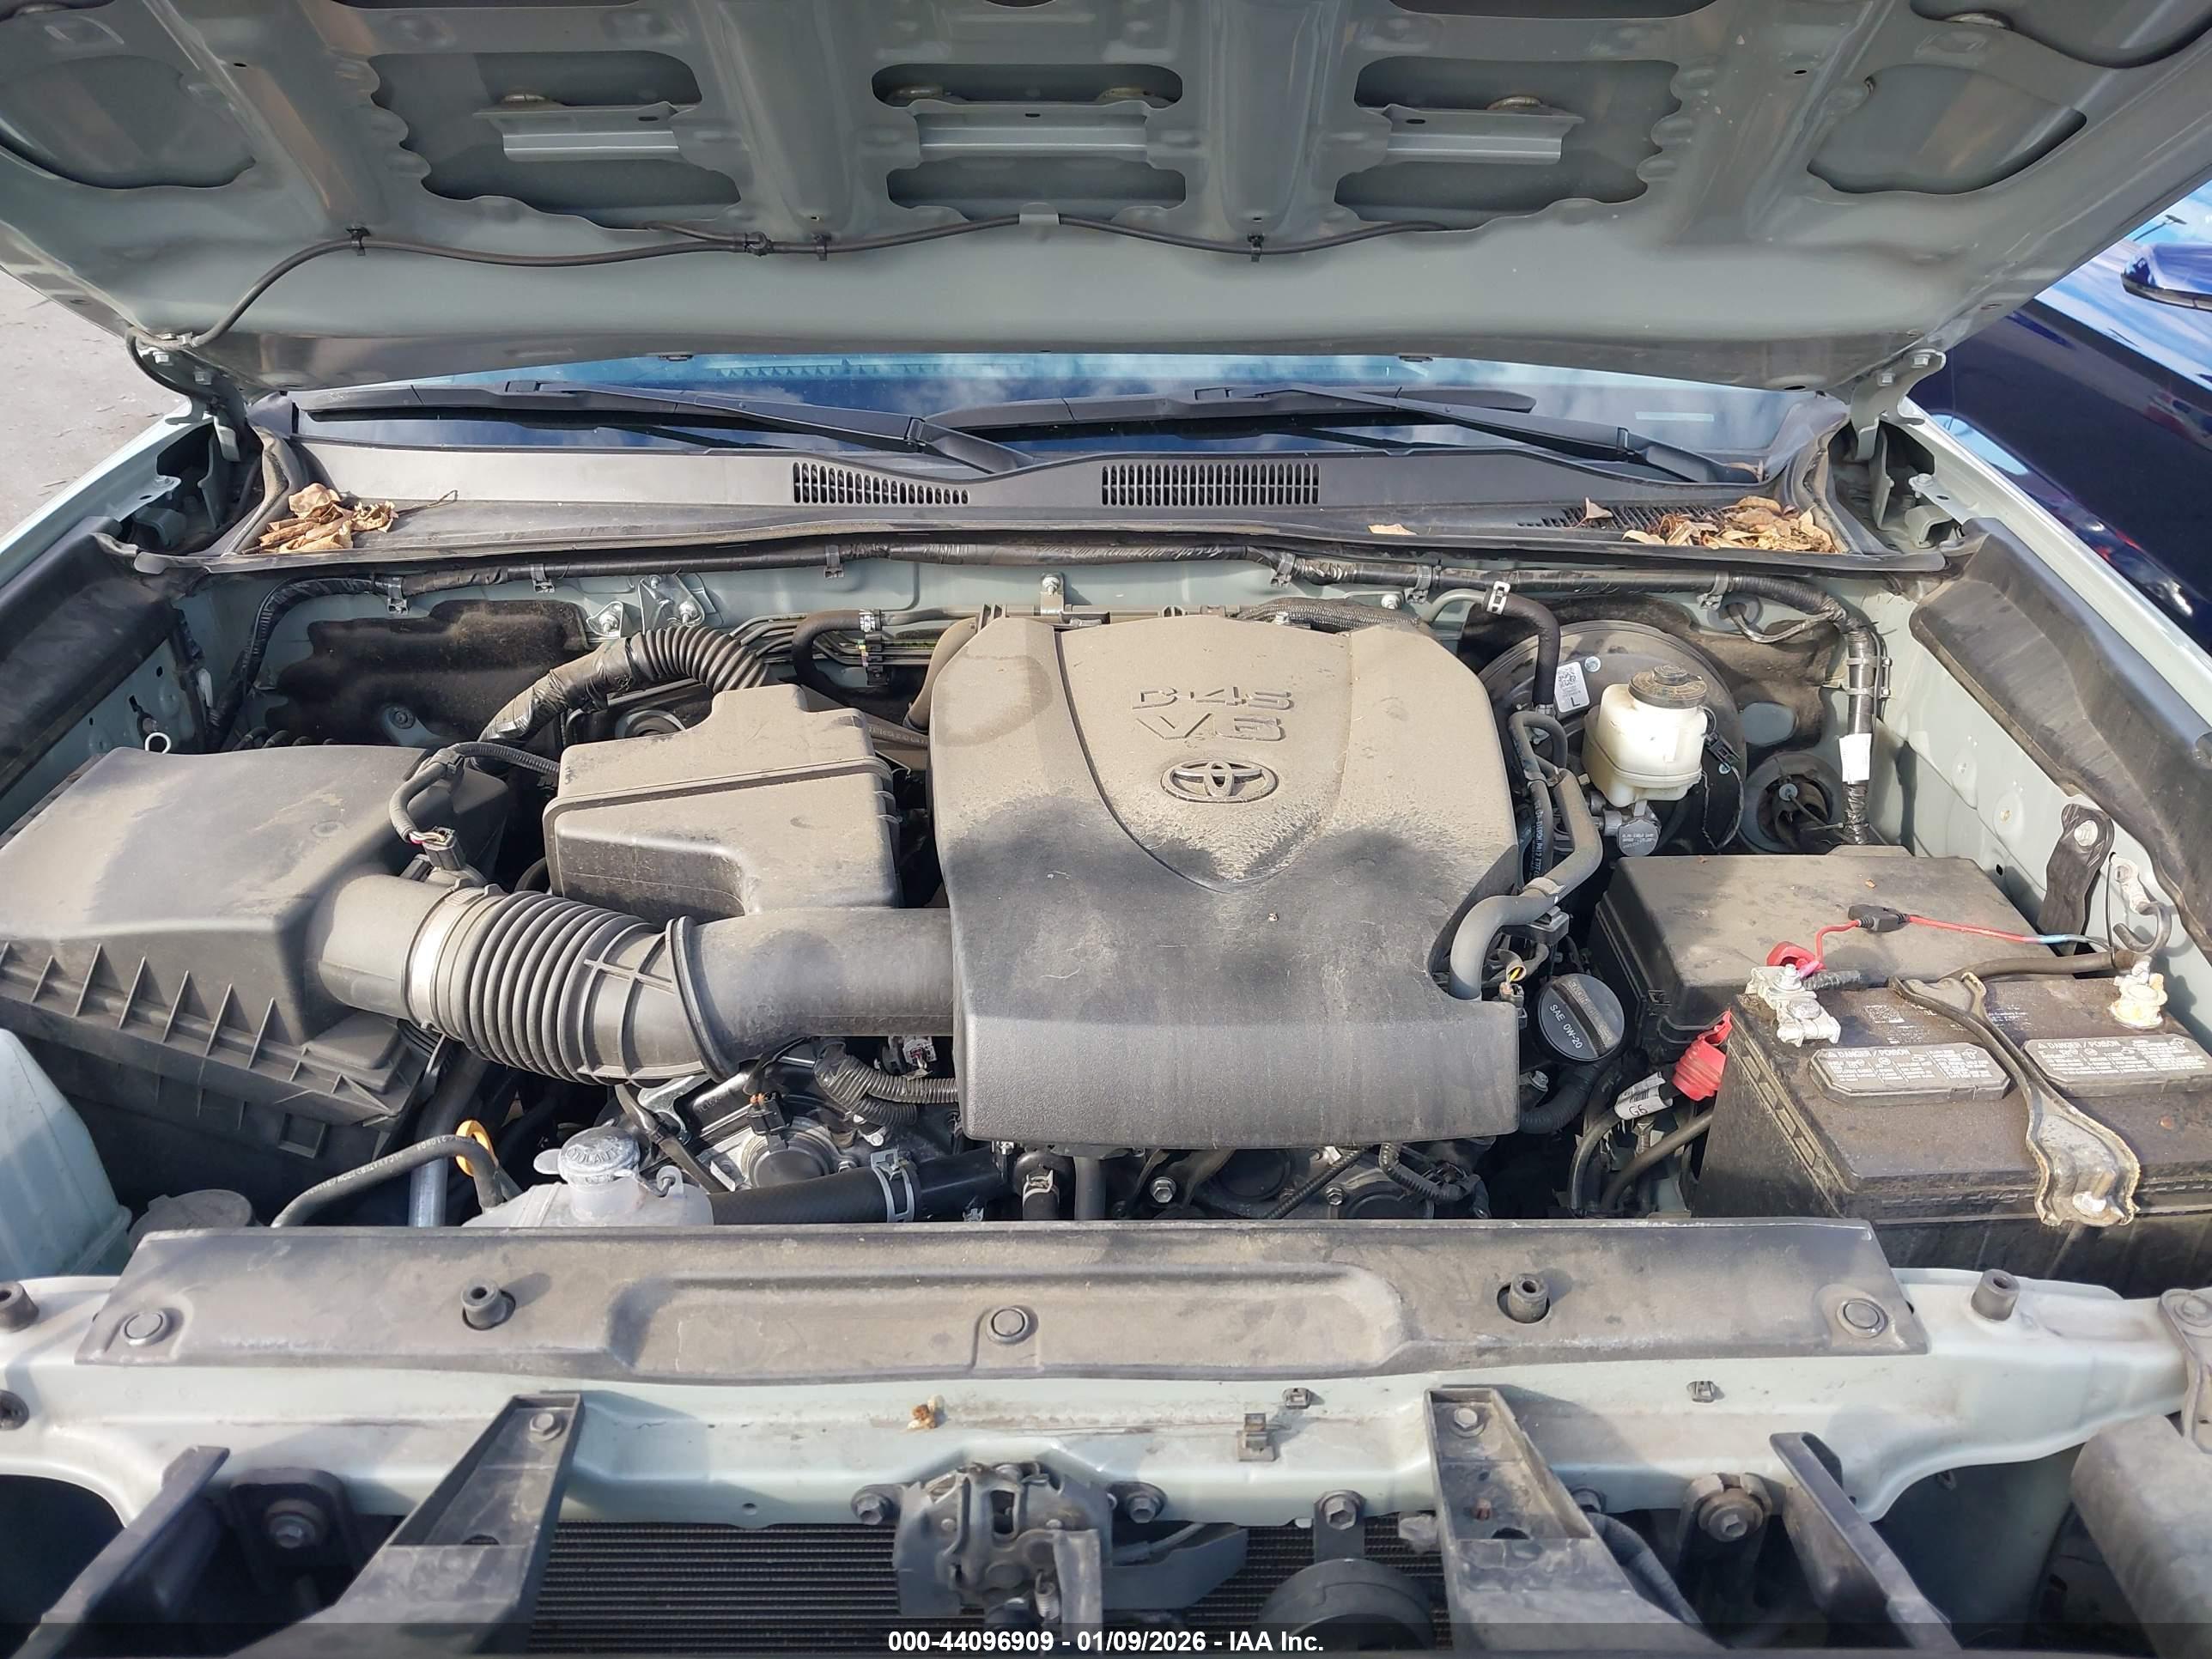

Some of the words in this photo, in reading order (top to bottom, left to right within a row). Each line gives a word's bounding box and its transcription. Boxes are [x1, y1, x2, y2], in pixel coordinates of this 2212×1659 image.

[1571, 696, 1581, 708] L
[1135, 713, 1285, 741] V6
[1549, 1004, 1565, 1022] SAE
[1563, 1023, 1583, 1048] 0W-20
[1628, 1104, 1648, 1116] G6
